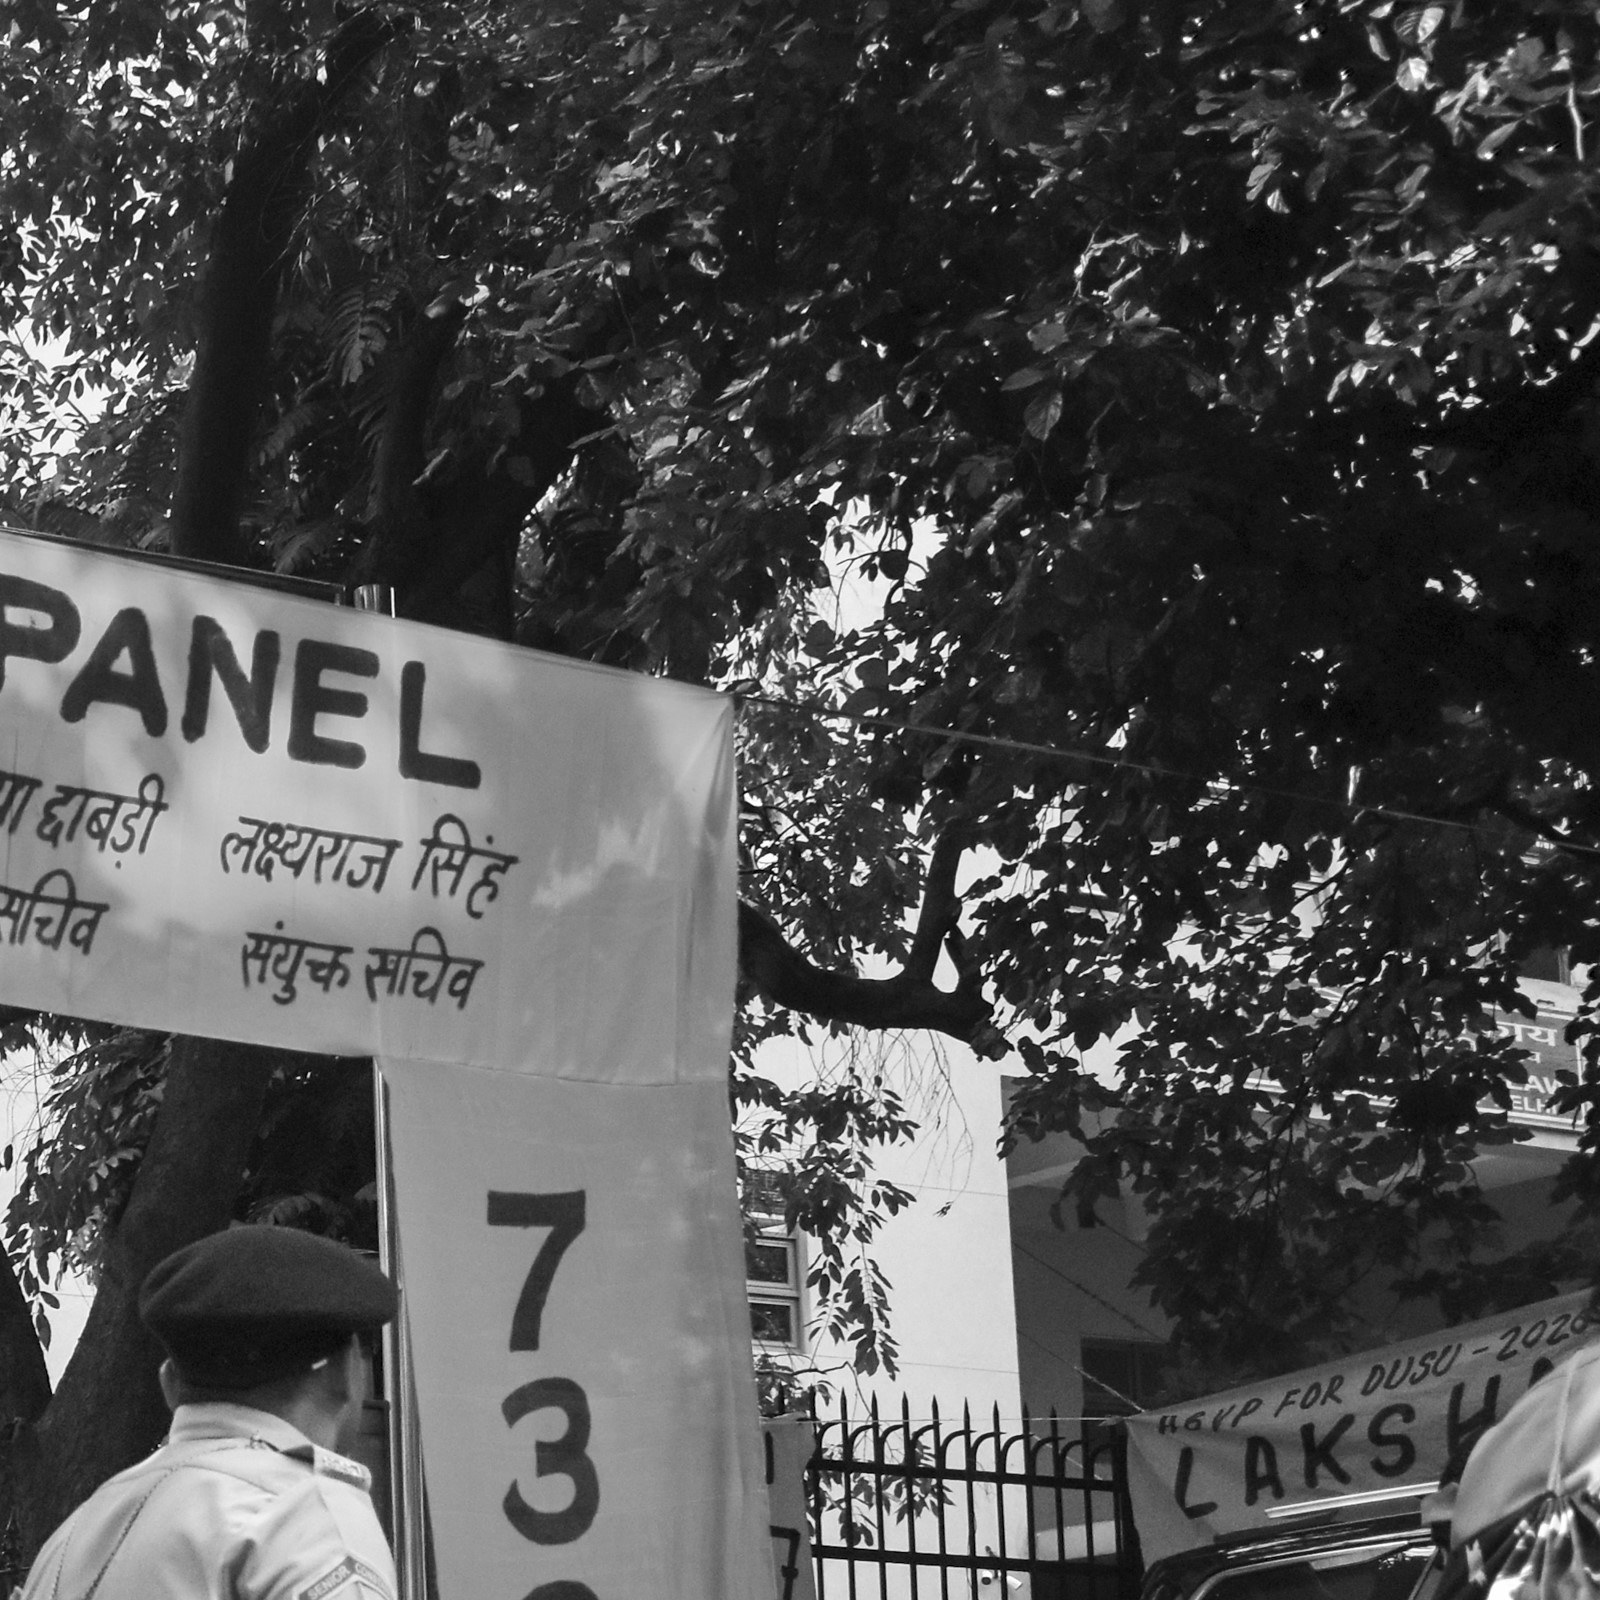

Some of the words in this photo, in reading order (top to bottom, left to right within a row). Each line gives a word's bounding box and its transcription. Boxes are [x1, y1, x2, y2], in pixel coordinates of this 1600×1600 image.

[218, 814, 404, 896] लक्ष्यराज
[410, 810, 521, 921] सिंह
[360, 924, 486, 1013] सचिव
[1273, 1373, 1346, 1420] FOR
[1359, 1341, 1466, 1398] DUSU
